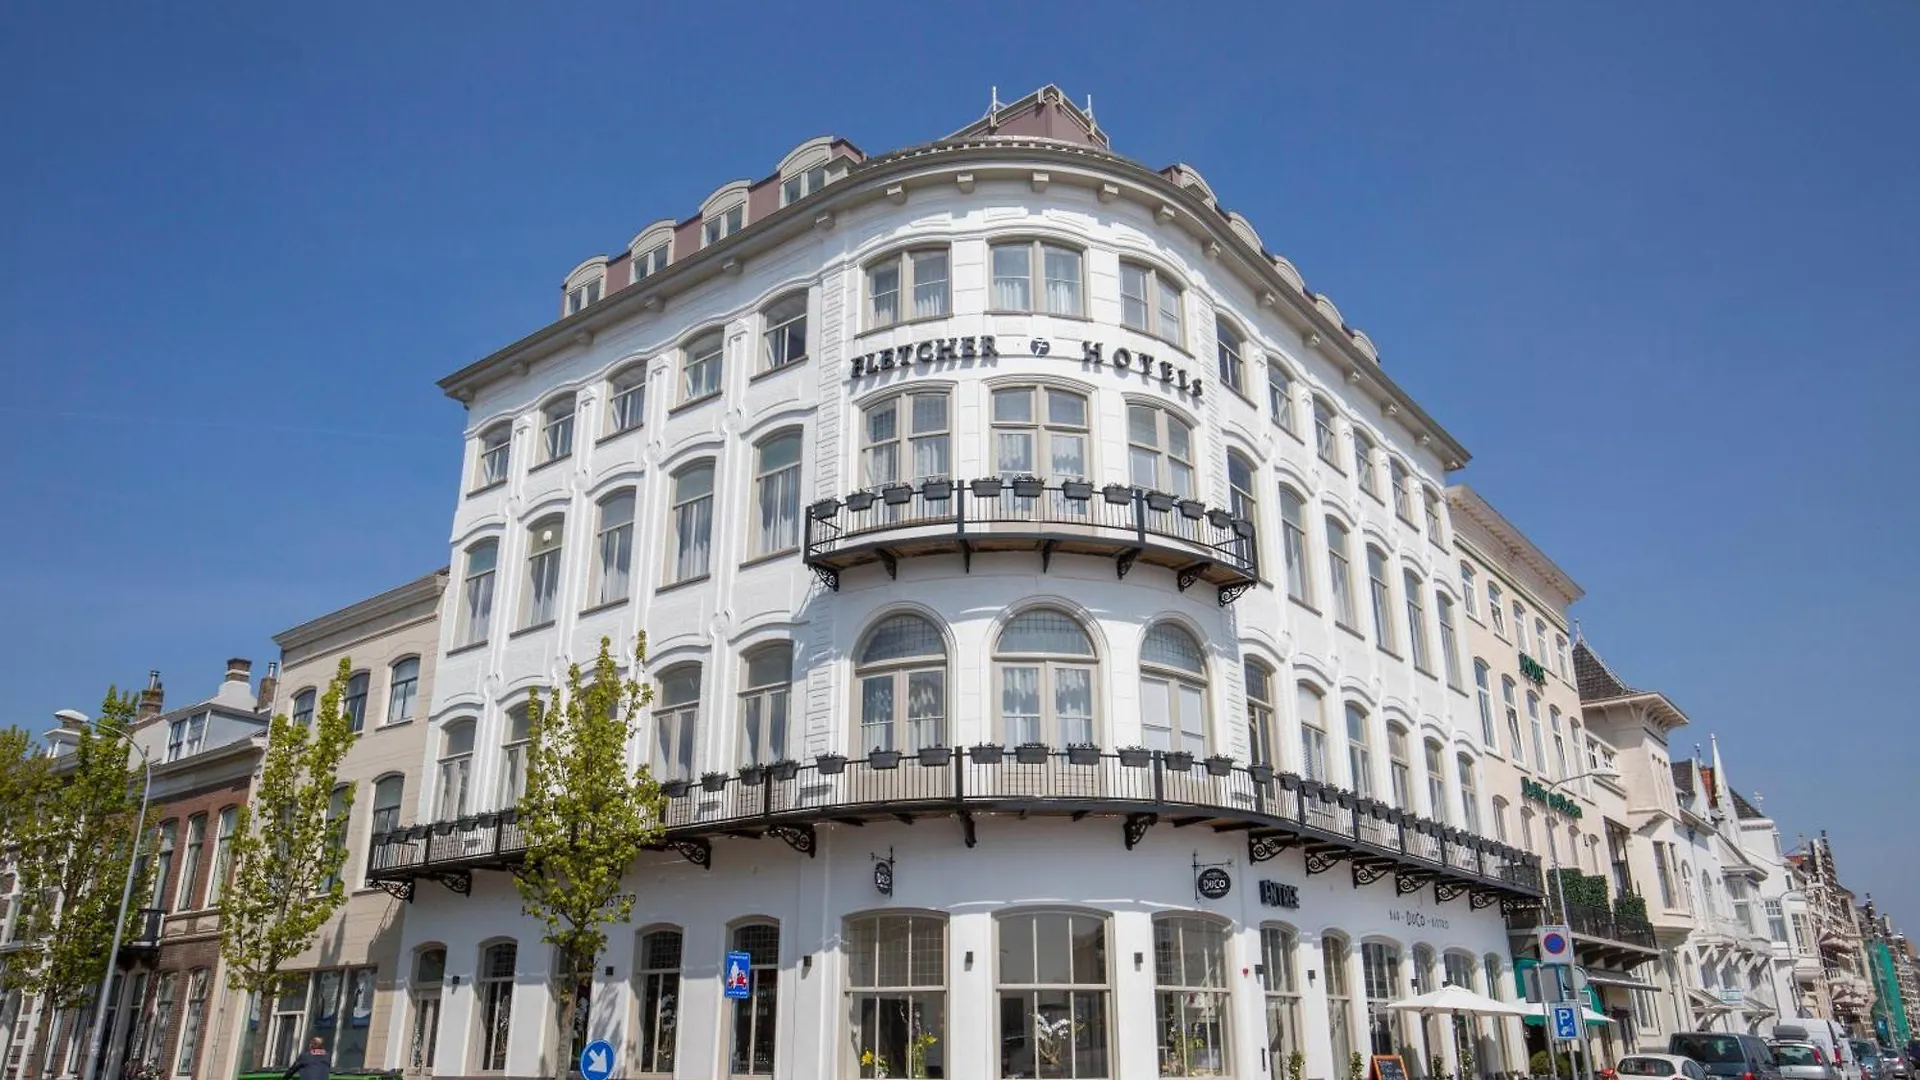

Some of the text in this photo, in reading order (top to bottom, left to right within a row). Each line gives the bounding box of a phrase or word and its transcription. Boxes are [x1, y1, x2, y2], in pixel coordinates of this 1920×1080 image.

[850, 335, 999, 379] FLETCHER
[1081, 340, 1204, 398] HOTELS
[1203, 879, 1226, 890] DUCO
[1558, 1009, 1571, 1025] P
